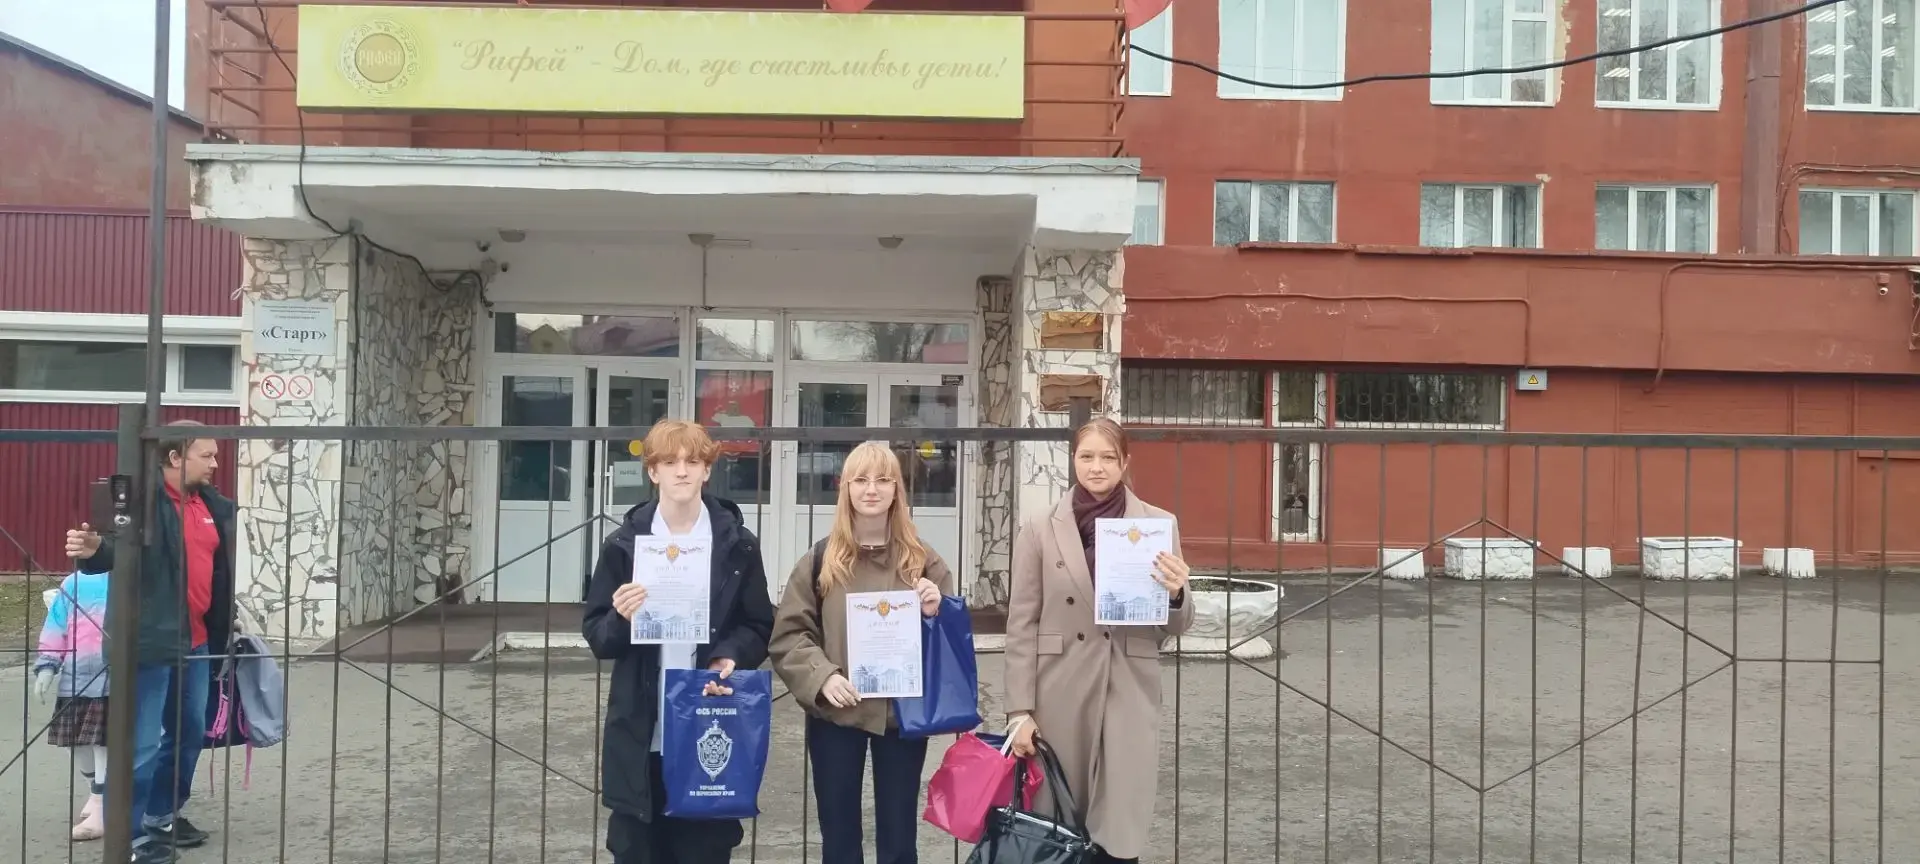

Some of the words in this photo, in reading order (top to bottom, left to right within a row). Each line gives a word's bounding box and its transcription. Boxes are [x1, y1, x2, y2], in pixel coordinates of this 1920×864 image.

[613, 40, 692, 77] Дом,
[699, 59, 741, 87] где
[749, 48, 911, 77] счастливы
[912, 56, 1008, 91] дети!
[261, 325, 328, 343] «Старт»
[695, 707, 711, 716] ФСБ
[711, 707, 737, 716] РОССИИ
